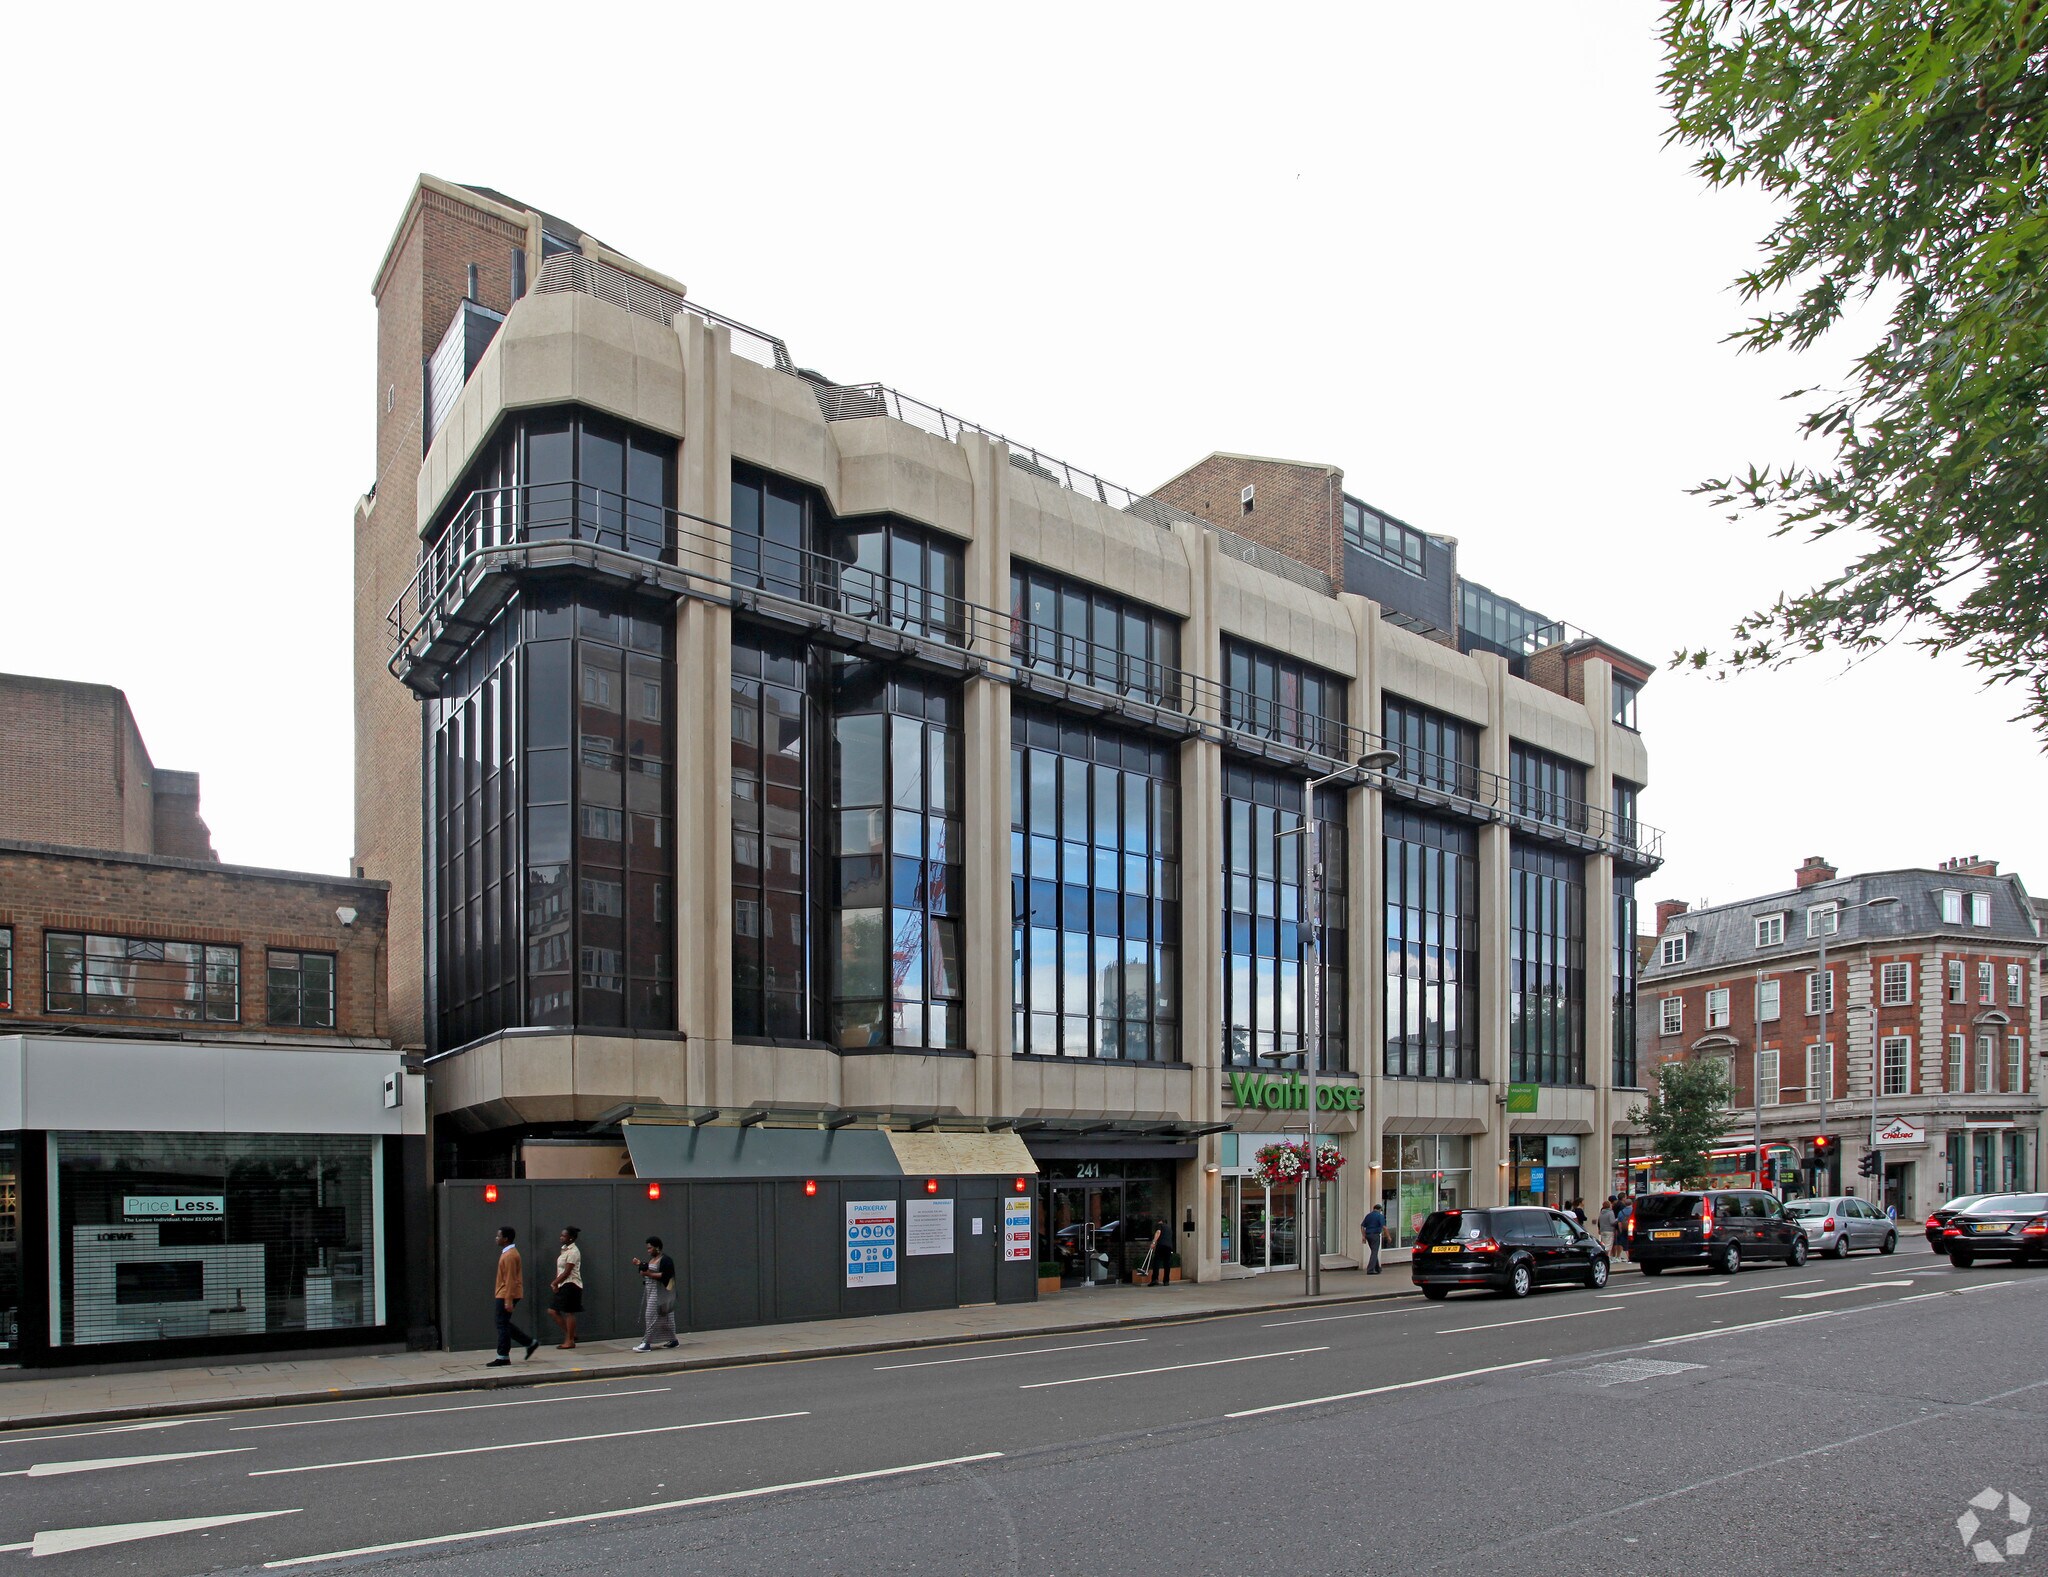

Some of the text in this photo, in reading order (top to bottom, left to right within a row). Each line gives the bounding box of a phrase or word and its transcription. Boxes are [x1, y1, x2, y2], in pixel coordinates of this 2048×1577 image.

[1229, 1071, 1361, 1111] Waitrose
[1077, 1163, 1099, 1178] 241
[128, 1199, 219, 1212] Price. Less.
